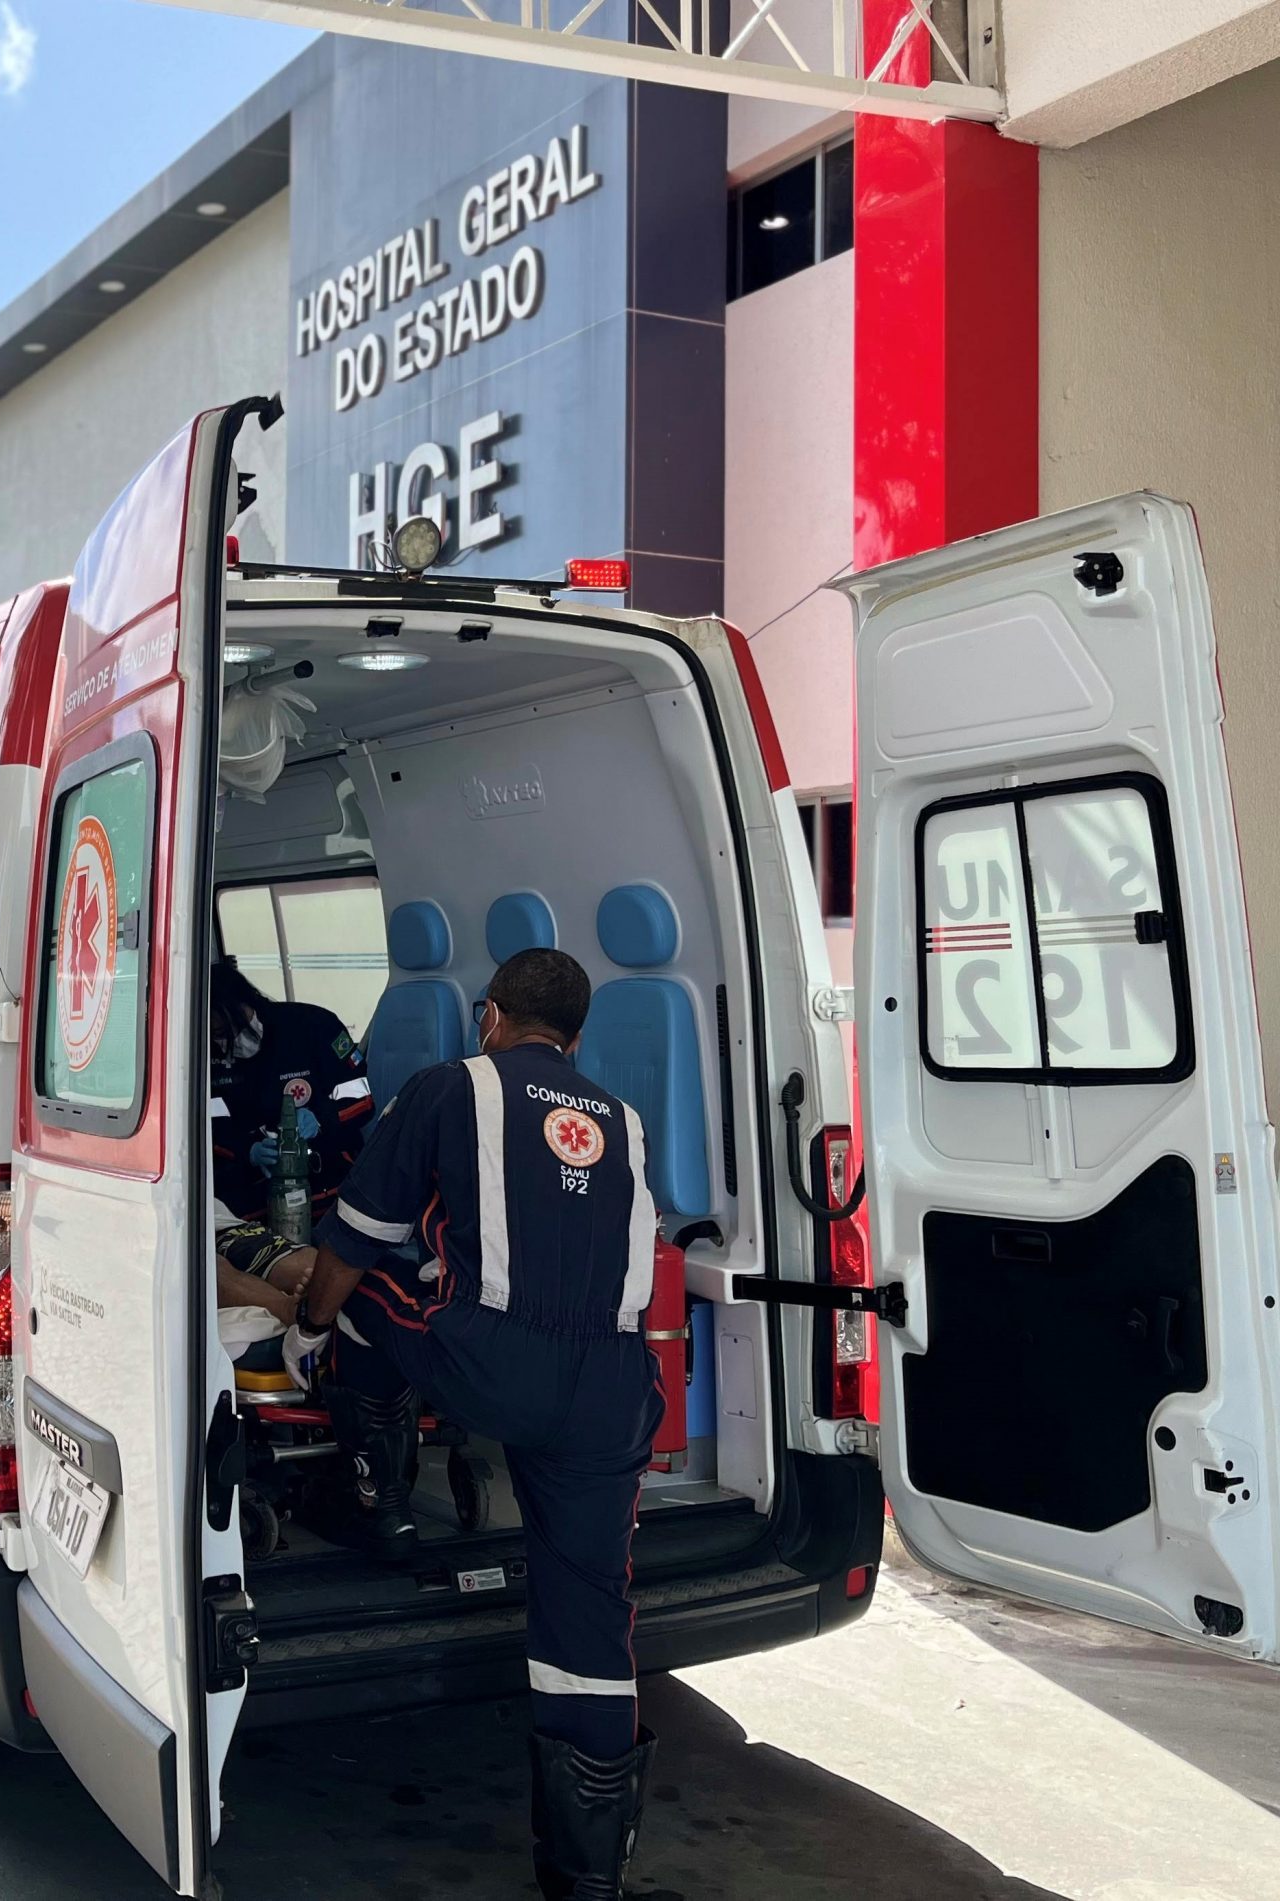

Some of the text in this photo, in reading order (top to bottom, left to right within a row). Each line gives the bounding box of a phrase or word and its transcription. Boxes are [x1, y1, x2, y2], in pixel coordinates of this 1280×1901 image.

[296, 124, 600, 356] HOSPITAL GERAL
[335, 245, 543, 412] DO ESTADO
[349, 410, 504, 572] HGE
[64, 676, 96, 717] SERVIÇO
[97, 666, 110, 694] DE
[526, 1084, 612, 1117] CONDUTOR
[560, 1165, 590, 1180] SAMU
[561, 1176, 588, 1195] 192
[70, 1292, 105, 1320] RASTREADO
[31, 1409, 82, 1467] MASTER
